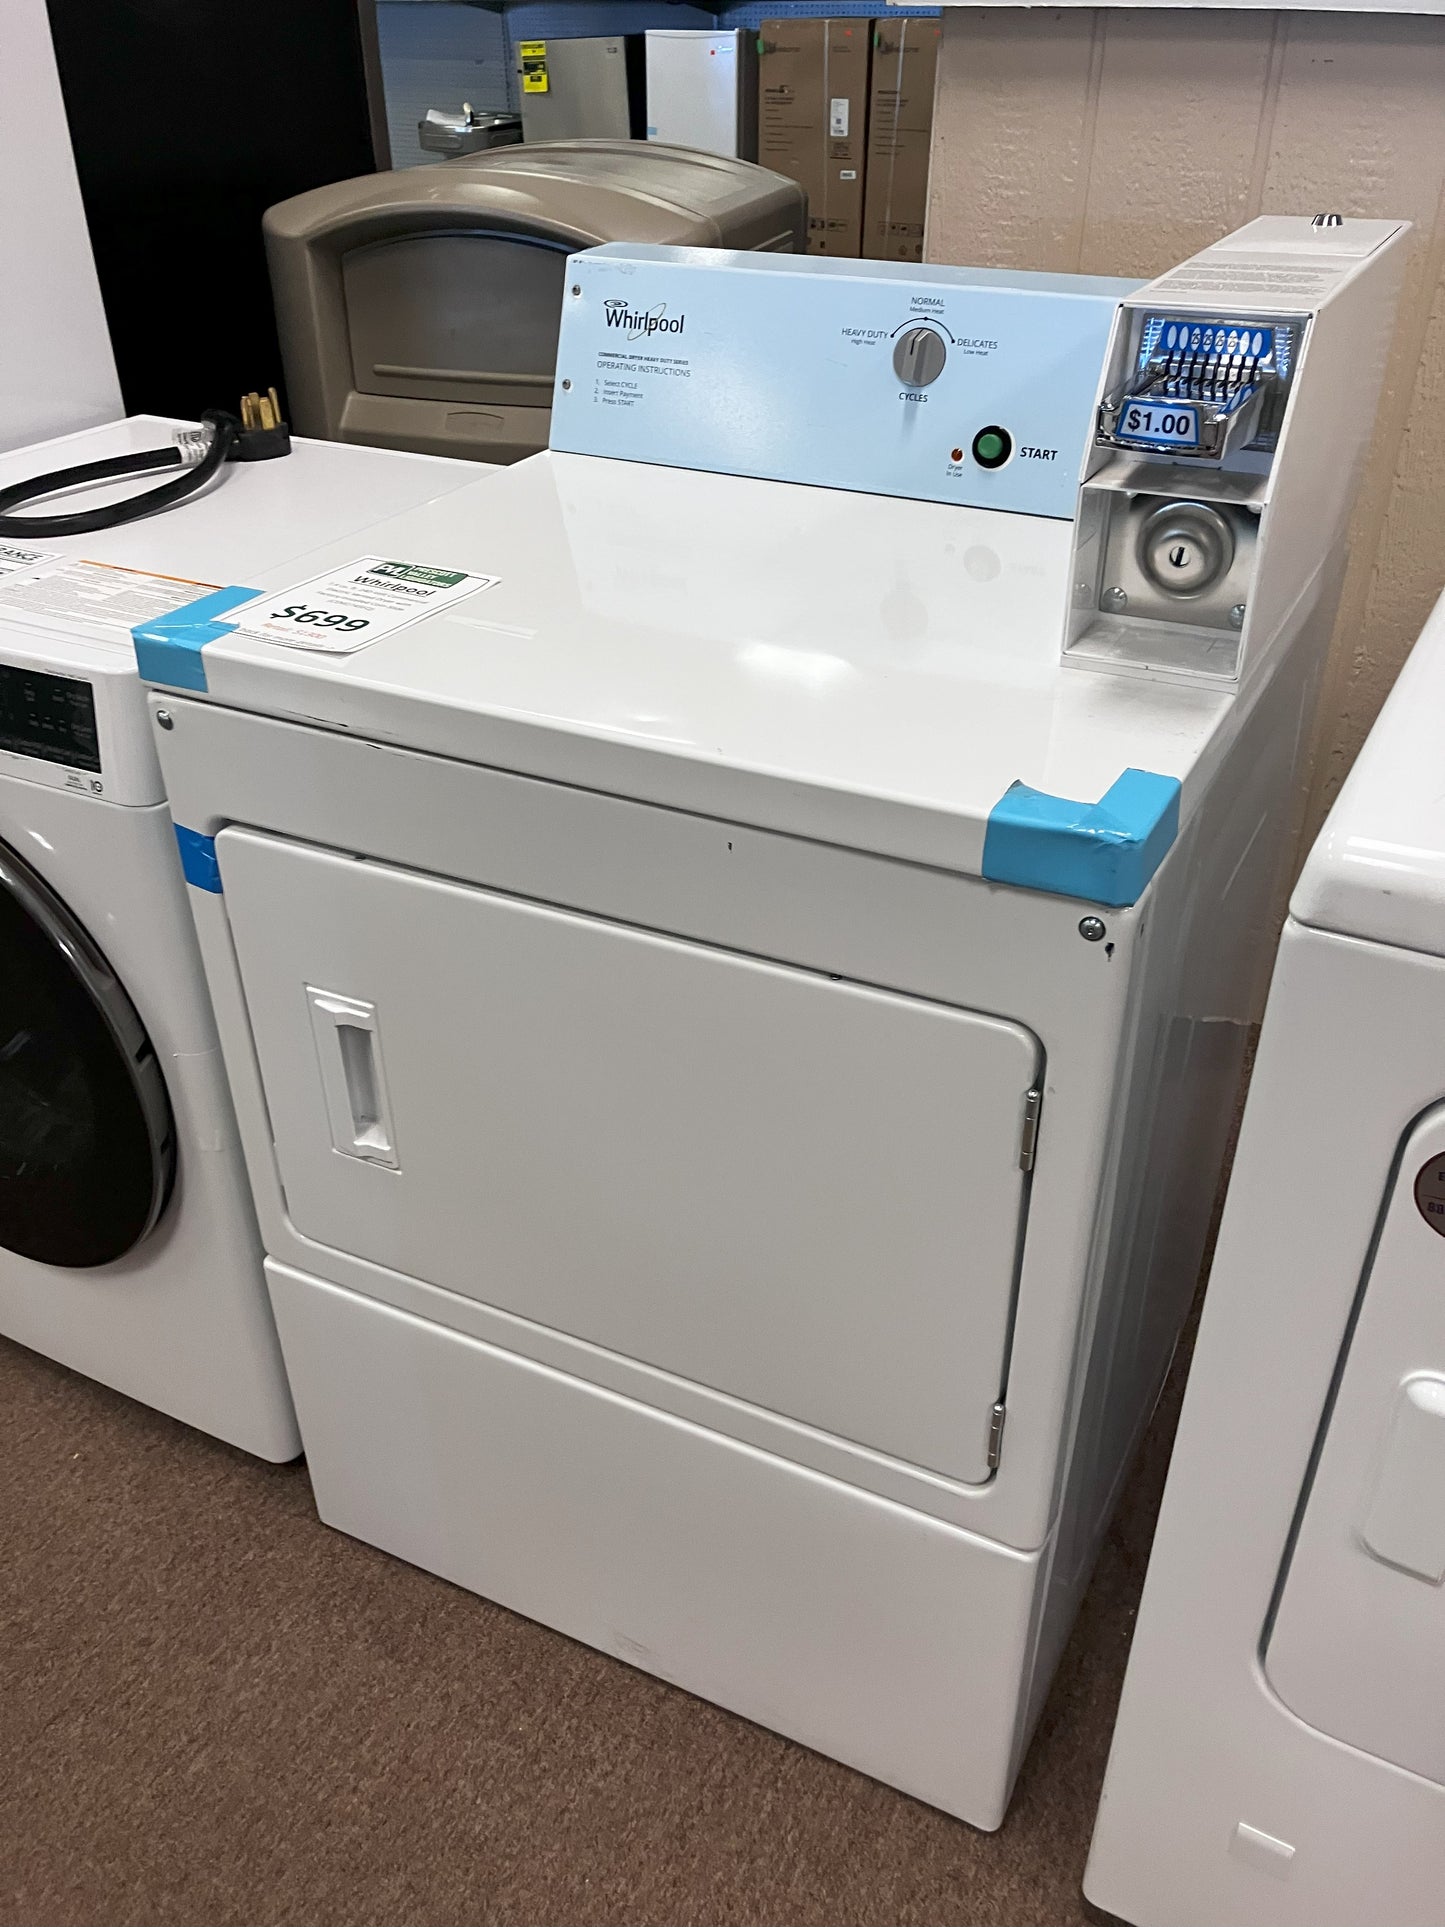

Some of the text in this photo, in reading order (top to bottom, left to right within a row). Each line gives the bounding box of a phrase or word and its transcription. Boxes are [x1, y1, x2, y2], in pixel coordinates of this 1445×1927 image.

[911, 297, 945, 307] NORMAL
[605, 307, 685, 337] Whirlpool
[841, 328, 889, 339] HEAVY DUTY
[957, 338, 998, 349] DELICATES
[596, 361, 691, 378] OPERATING INSTRUCTIONS
[621, 381, 639, 390] CYCLE
[899, 392, 928, 402] CYCLES
[1127, 408, 1191, 437] $1.00
[1019, 447, 1058, 461] START
[353, 575, 437, 597] Whirlpool
[270, 604, 370, 632] $699
